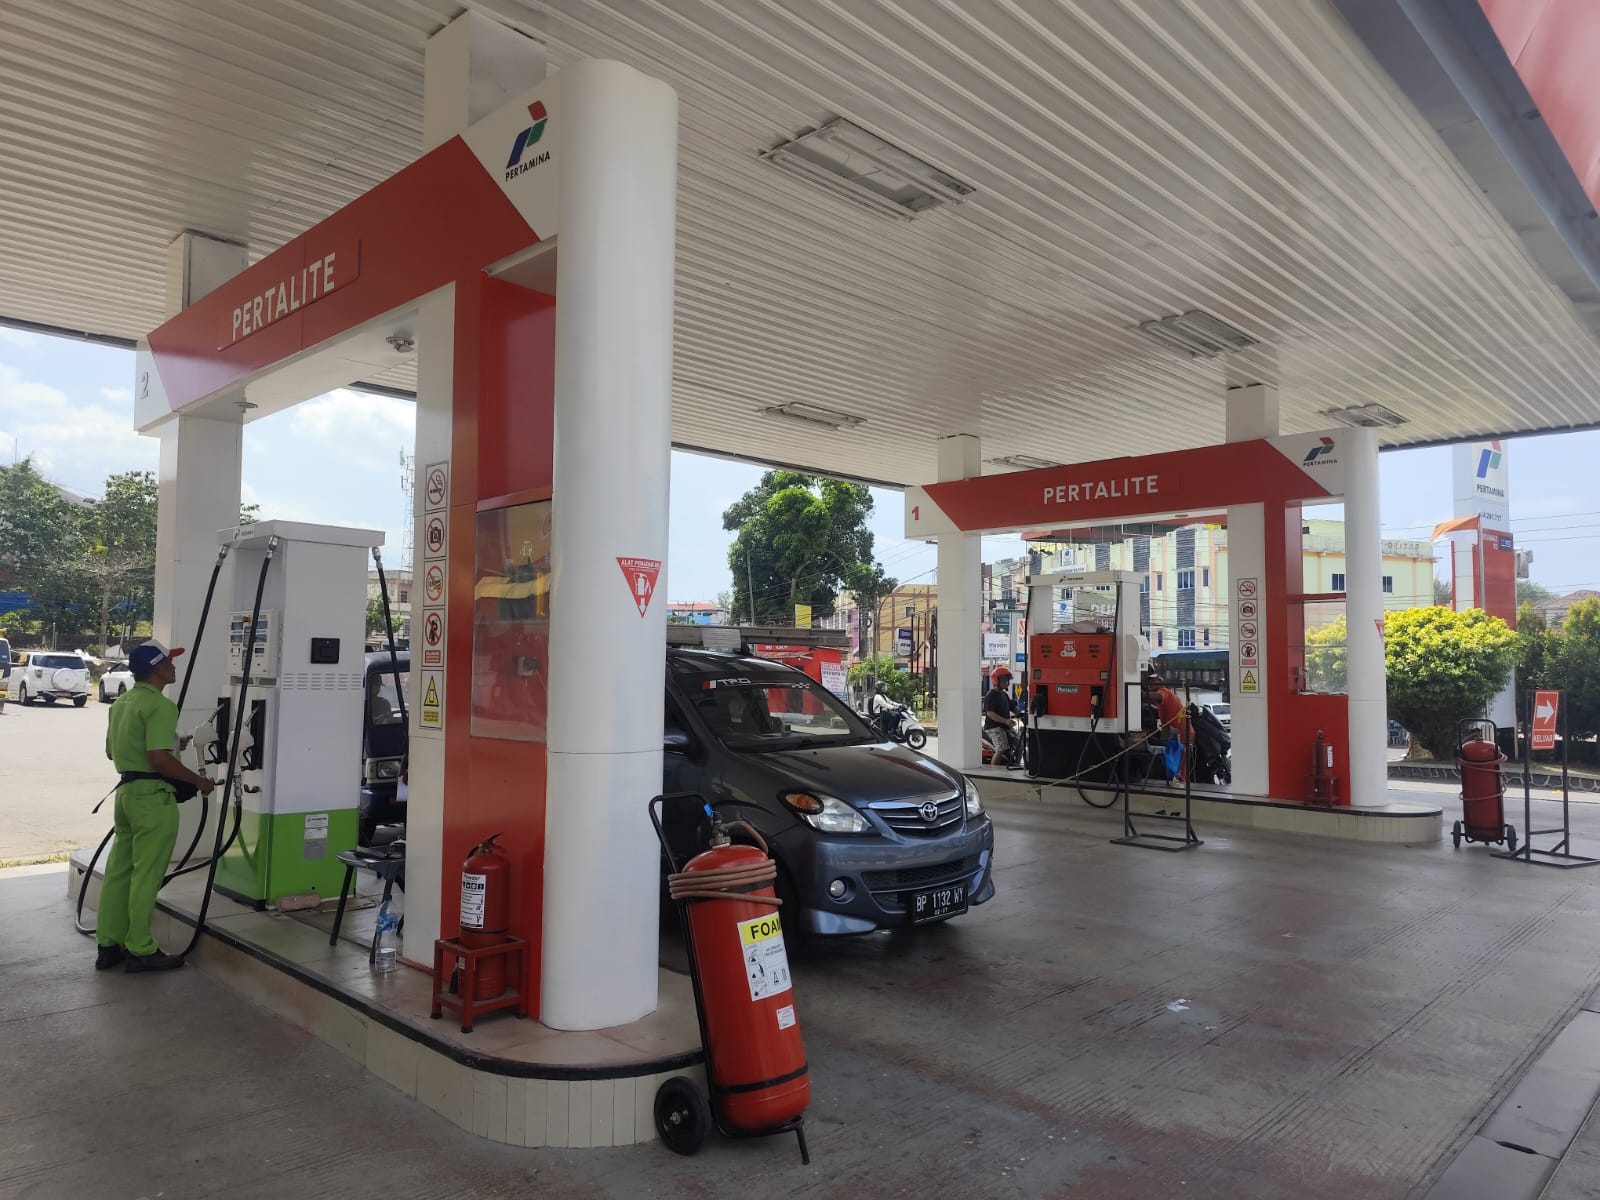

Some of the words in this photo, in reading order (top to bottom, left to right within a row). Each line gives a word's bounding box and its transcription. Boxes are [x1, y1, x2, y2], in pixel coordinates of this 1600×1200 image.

[505, 151, 550, 182] PERTAMINA
[232, 252, 336, 342] PERTALITE
[139, 371, 149, 399] 2
[1303, 459, 1338, 467] PERTAMINA
[1043, 475, 1159, 505] PERTALITE
[1476, 483, 1505, 498] PERTAMINA
[911, 505, 920, 521] 1
[916, 895, 927, 912] BP
[933, 890, 951, 909] 1132
[953, 887, 964, 904] WY
